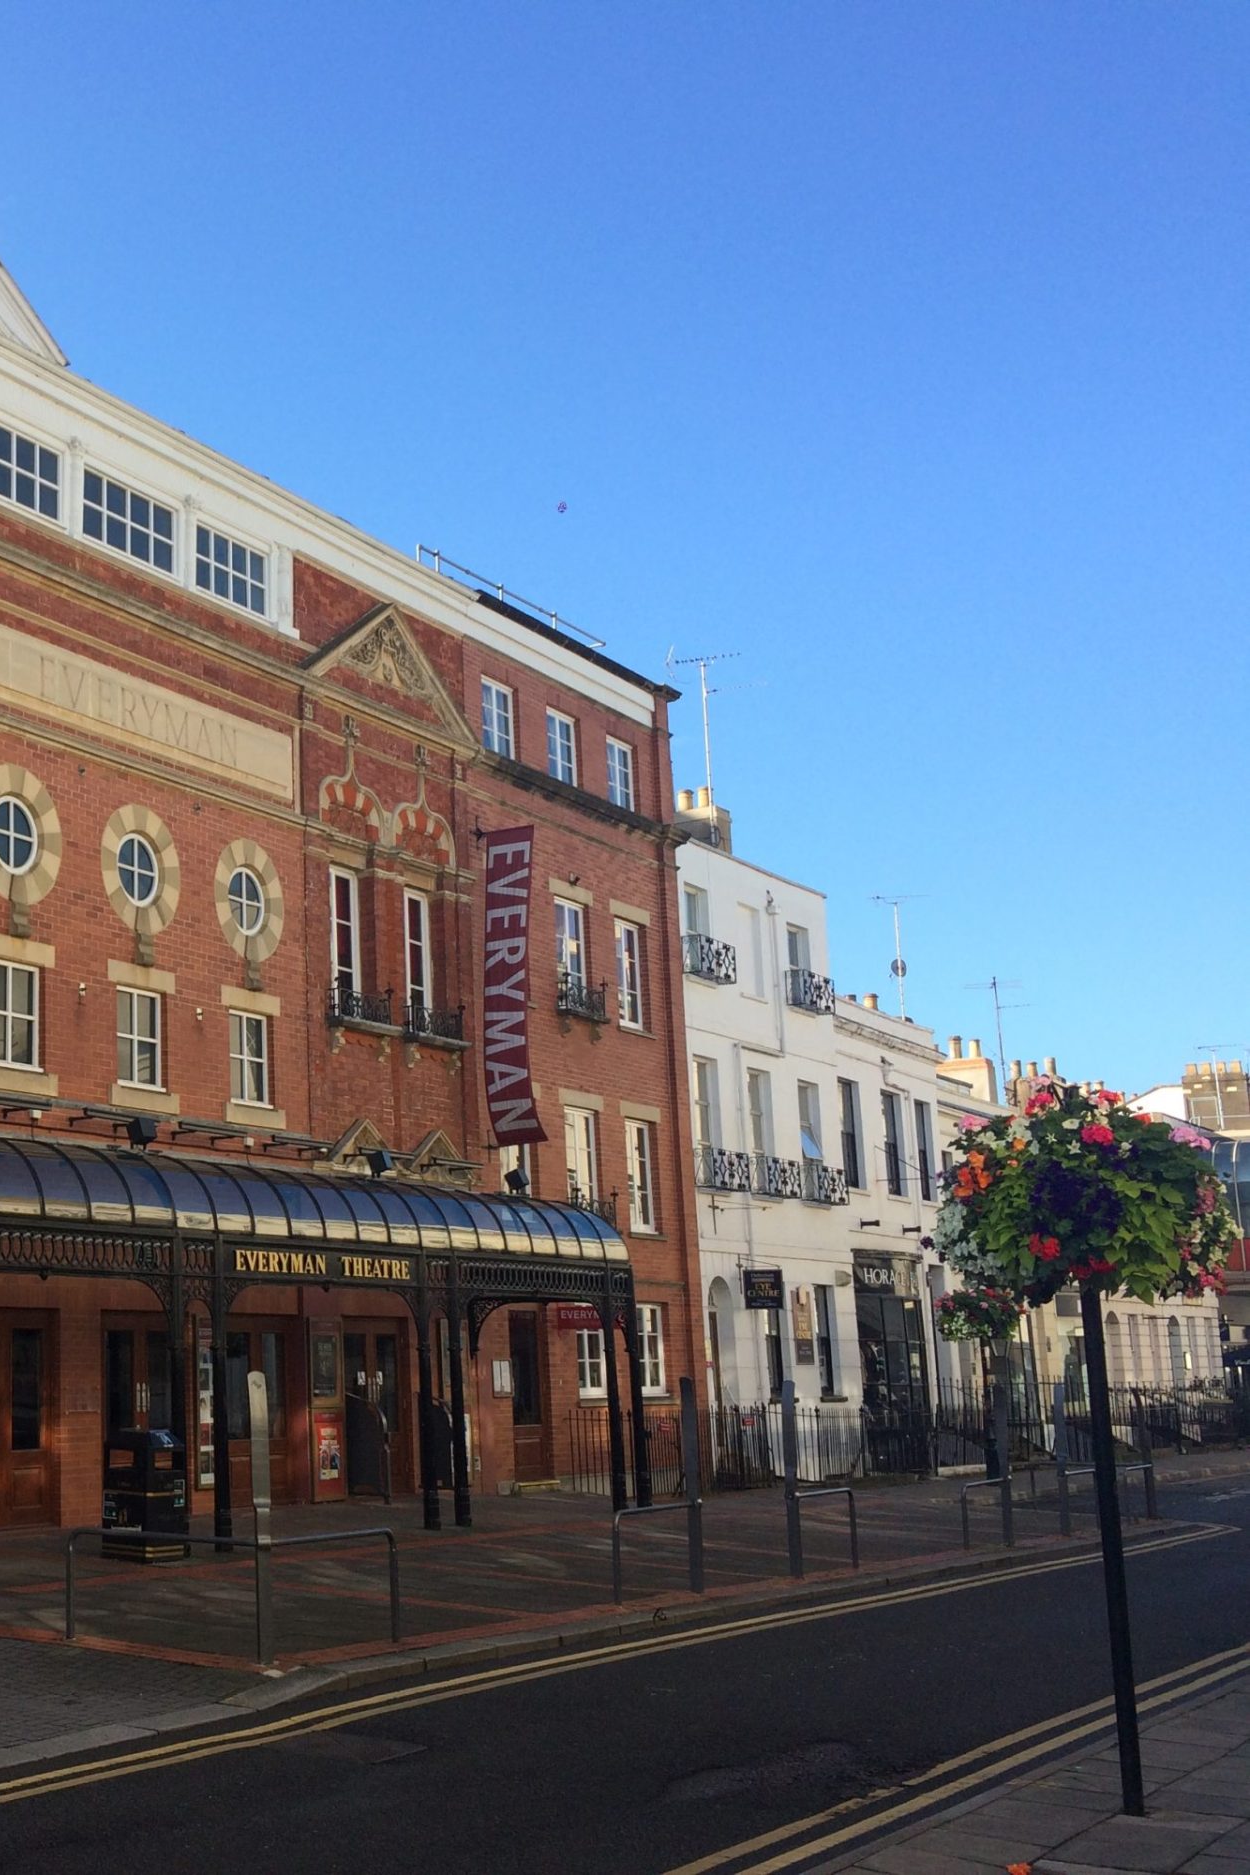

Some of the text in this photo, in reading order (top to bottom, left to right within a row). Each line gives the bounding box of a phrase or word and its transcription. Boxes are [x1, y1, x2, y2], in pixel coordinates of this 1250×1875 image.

[485, 841, 537, 1136] EVERYMAN
[235, 1250, 411, 1280] EVERYMAN THEATRE
